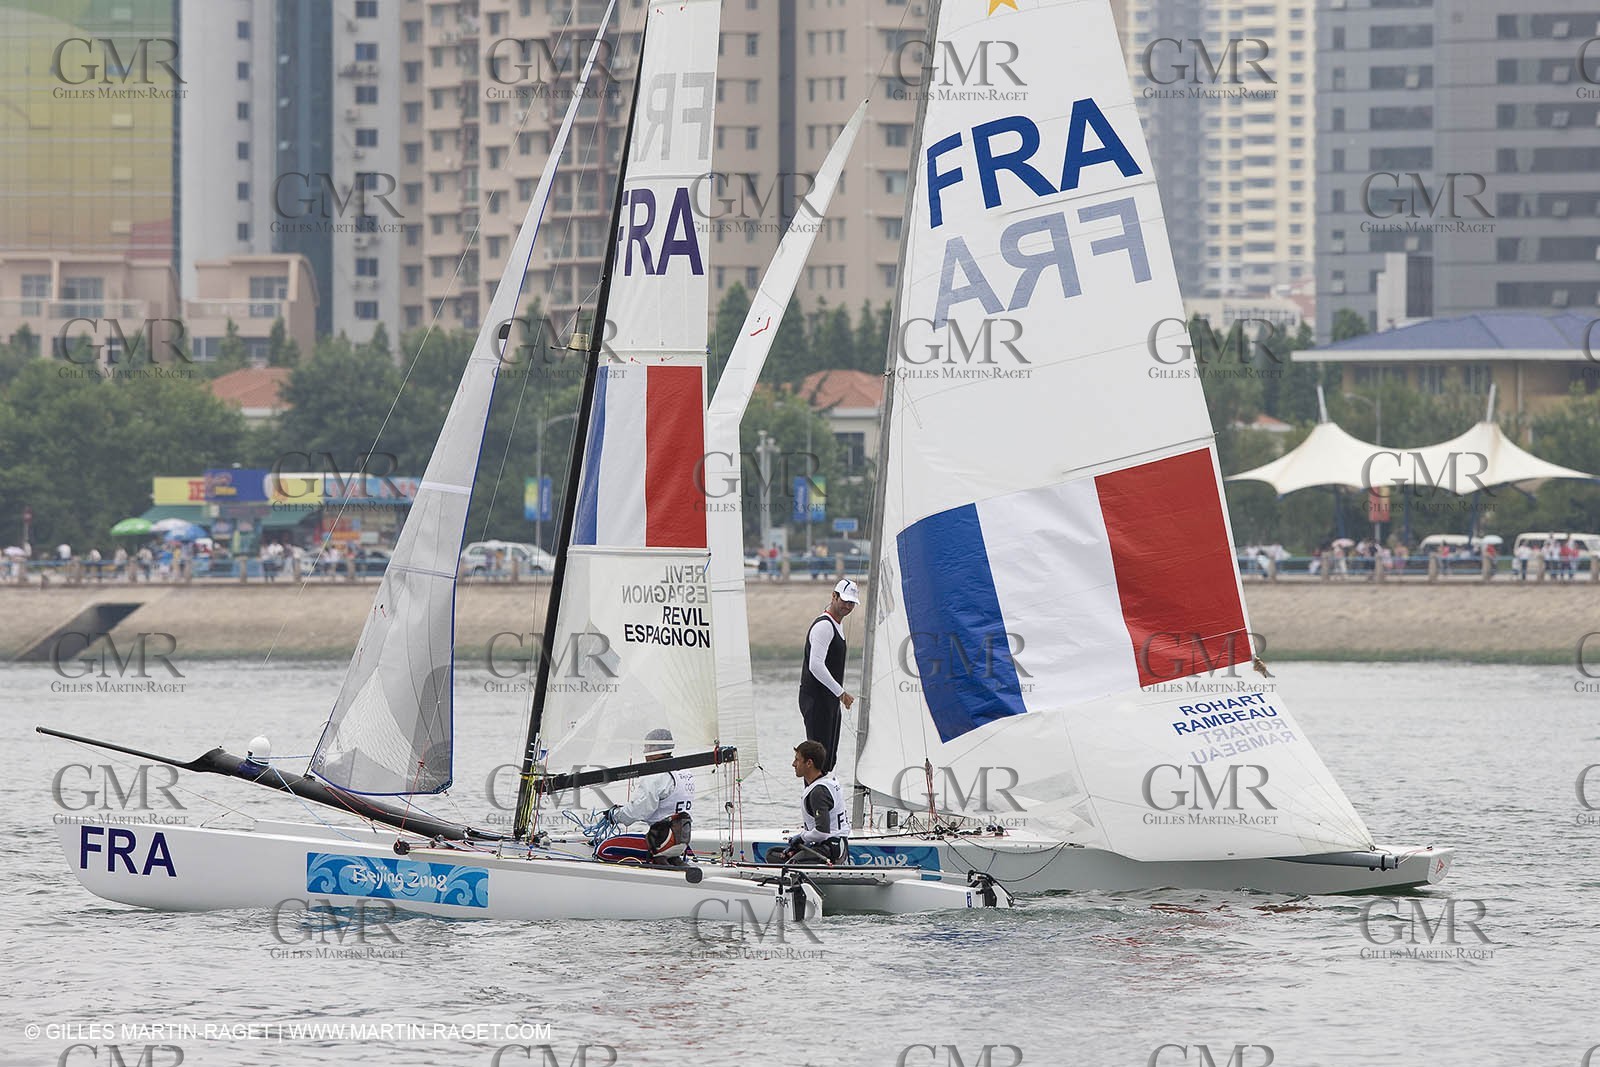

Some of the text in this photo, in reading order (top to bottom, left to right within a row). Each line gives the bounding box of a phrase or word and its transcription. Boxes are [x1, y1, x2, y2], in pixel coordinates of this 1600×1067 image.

[927, 98, 1142, 229] FRA
[662, 606, 709, 626] REVIL
[624, 624, 710, 648] ESPAGNON
[1179, 692, 1266, 716] ROHART
[1172, 706, 1277, 736] RAMBEAU
[80, 826, 176, 878] FRA
[347, 864, 448, 892] Beijing 2008
